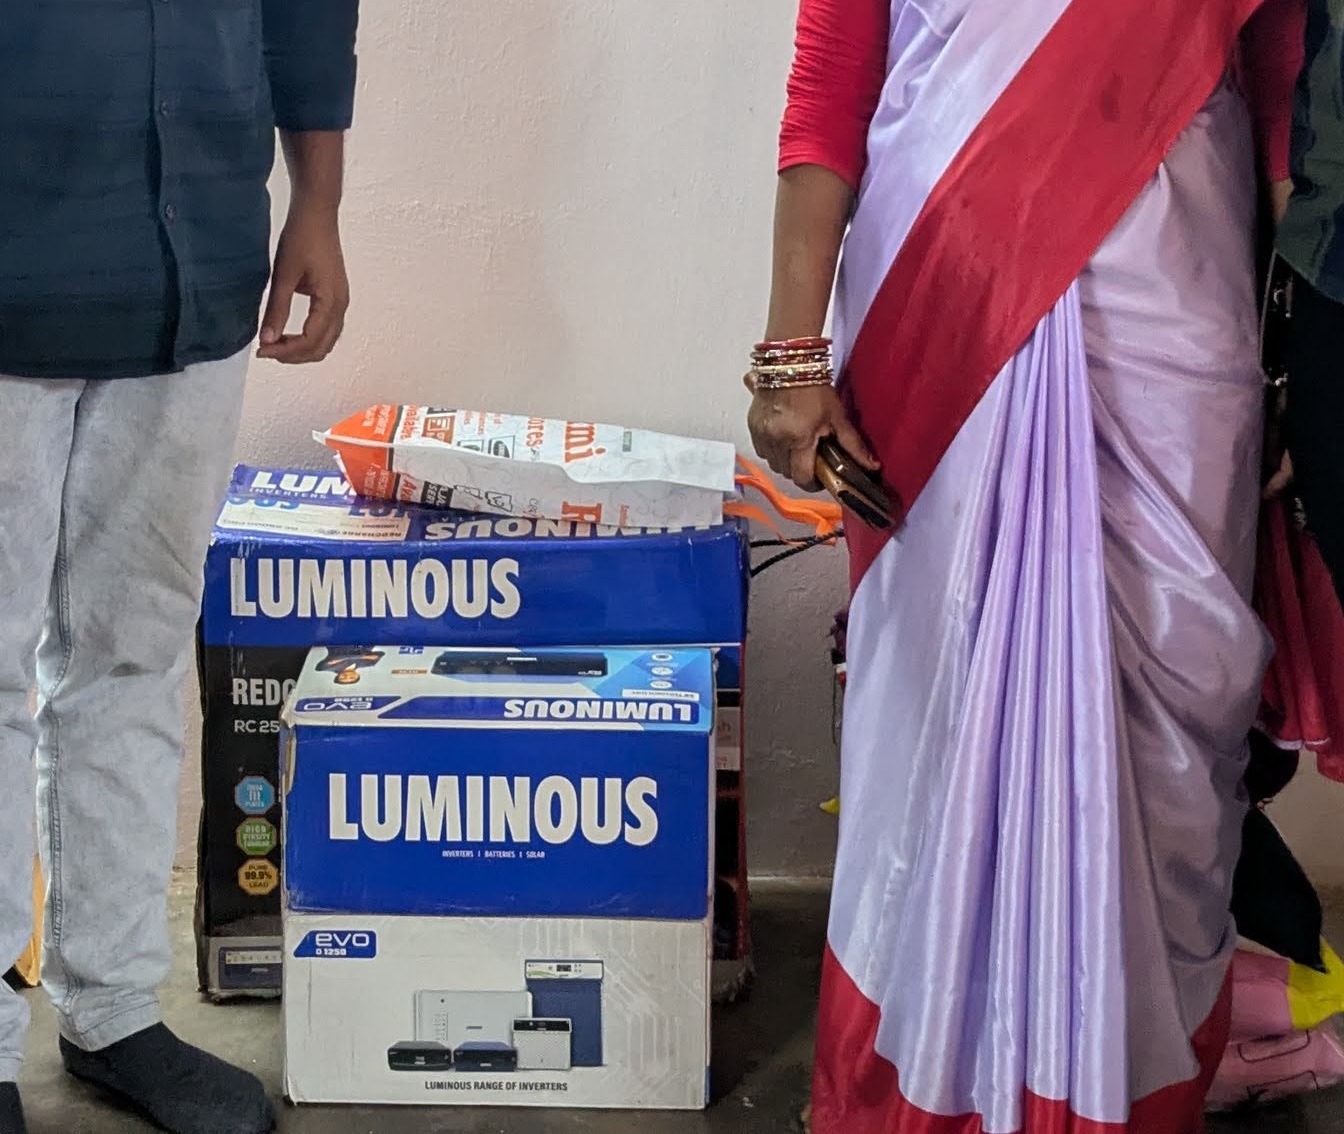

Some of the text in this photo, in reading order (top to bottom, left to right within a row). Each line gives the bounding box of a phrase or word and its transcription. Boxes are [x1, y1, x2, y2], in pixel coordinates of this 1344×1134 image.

[562, 421, 608, 464] mi
[230, 557, 522, 619] LUMINOUS
[504, 698, 692, 722] LUMINOUS
[234, 719, 281, 734] RC 25
[329, 773, 659, 847] LUMINOUS
[315, 933, 370, 947] evo
[424, 1080, 568, 1091] LUMINOUS RANGE OF INVERTERS
